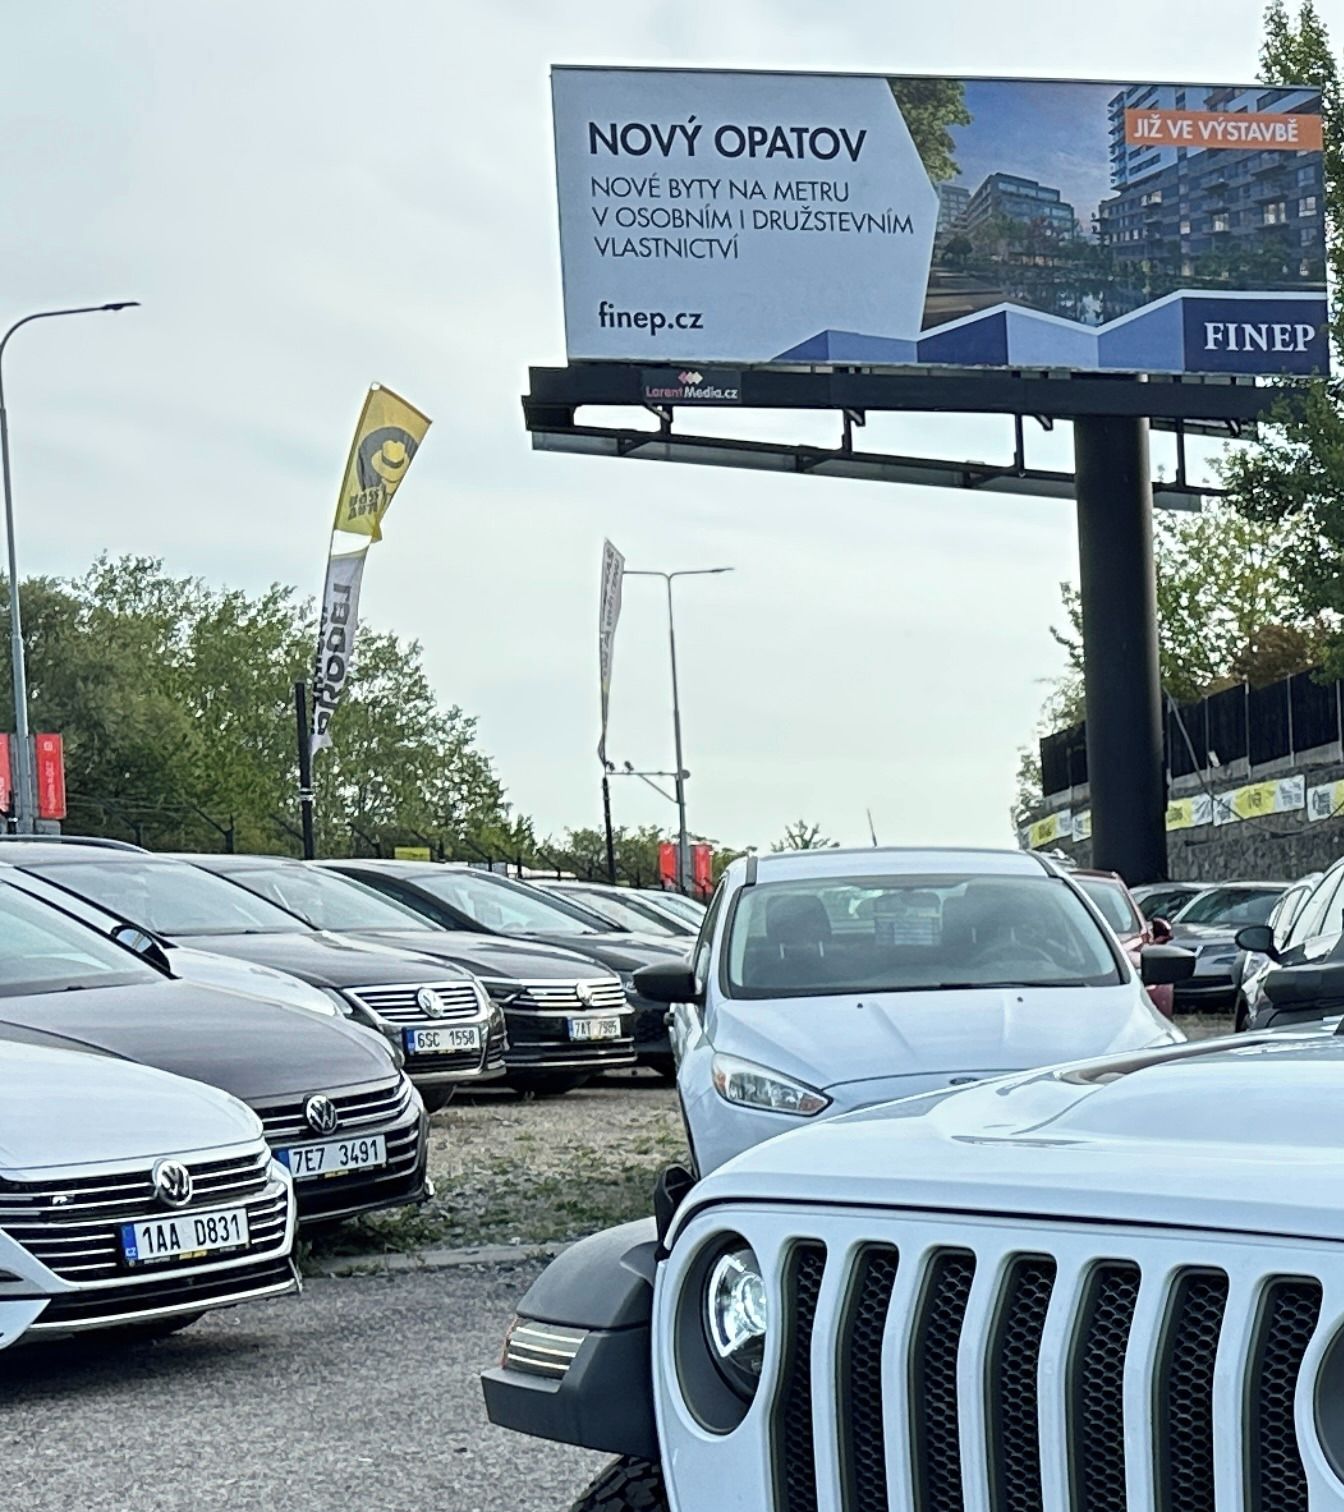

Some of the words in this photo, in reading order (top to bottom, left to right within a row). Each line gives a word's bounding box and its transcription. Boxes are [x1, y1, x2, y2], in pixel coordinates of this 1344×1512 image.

[589, 115, 702, 157] NOVÝ
[714, 125, 867, 162] OPATOV
[1134, 114, 1163, 138] JIŽ
[1167, 119, 1193, 139] VE
[1199, 117, 1299, 142] VÝSTAVBĚ
[591, 173, 660, 198] NOVÉ
[669, 178, 721, 199] BYTY
[730, 179, 767, 200] NA
[774, 181, 849, 202] METRU
[592, 207, 609, 227] V
[615, 203, 732, 230] OSOBNÍM
[740, 210, 745, 230] I
[753, 205, 914, 234] DRUŽSTEVNÍM
[593, 233, 739, 259] VLASTNICTVÍ
[599, 301, 703, 336] finep.cz
[1204, 322, 1315, 352] FINEP
[418, 1032, 440, 1048] 6SC
[293, 1147, 325, 1174] 7E7
[339, 1139, 379, 1166] 3491
[143, 1222, 181, 1254] 1AA
[194, 1214, 240, 1246] D831
